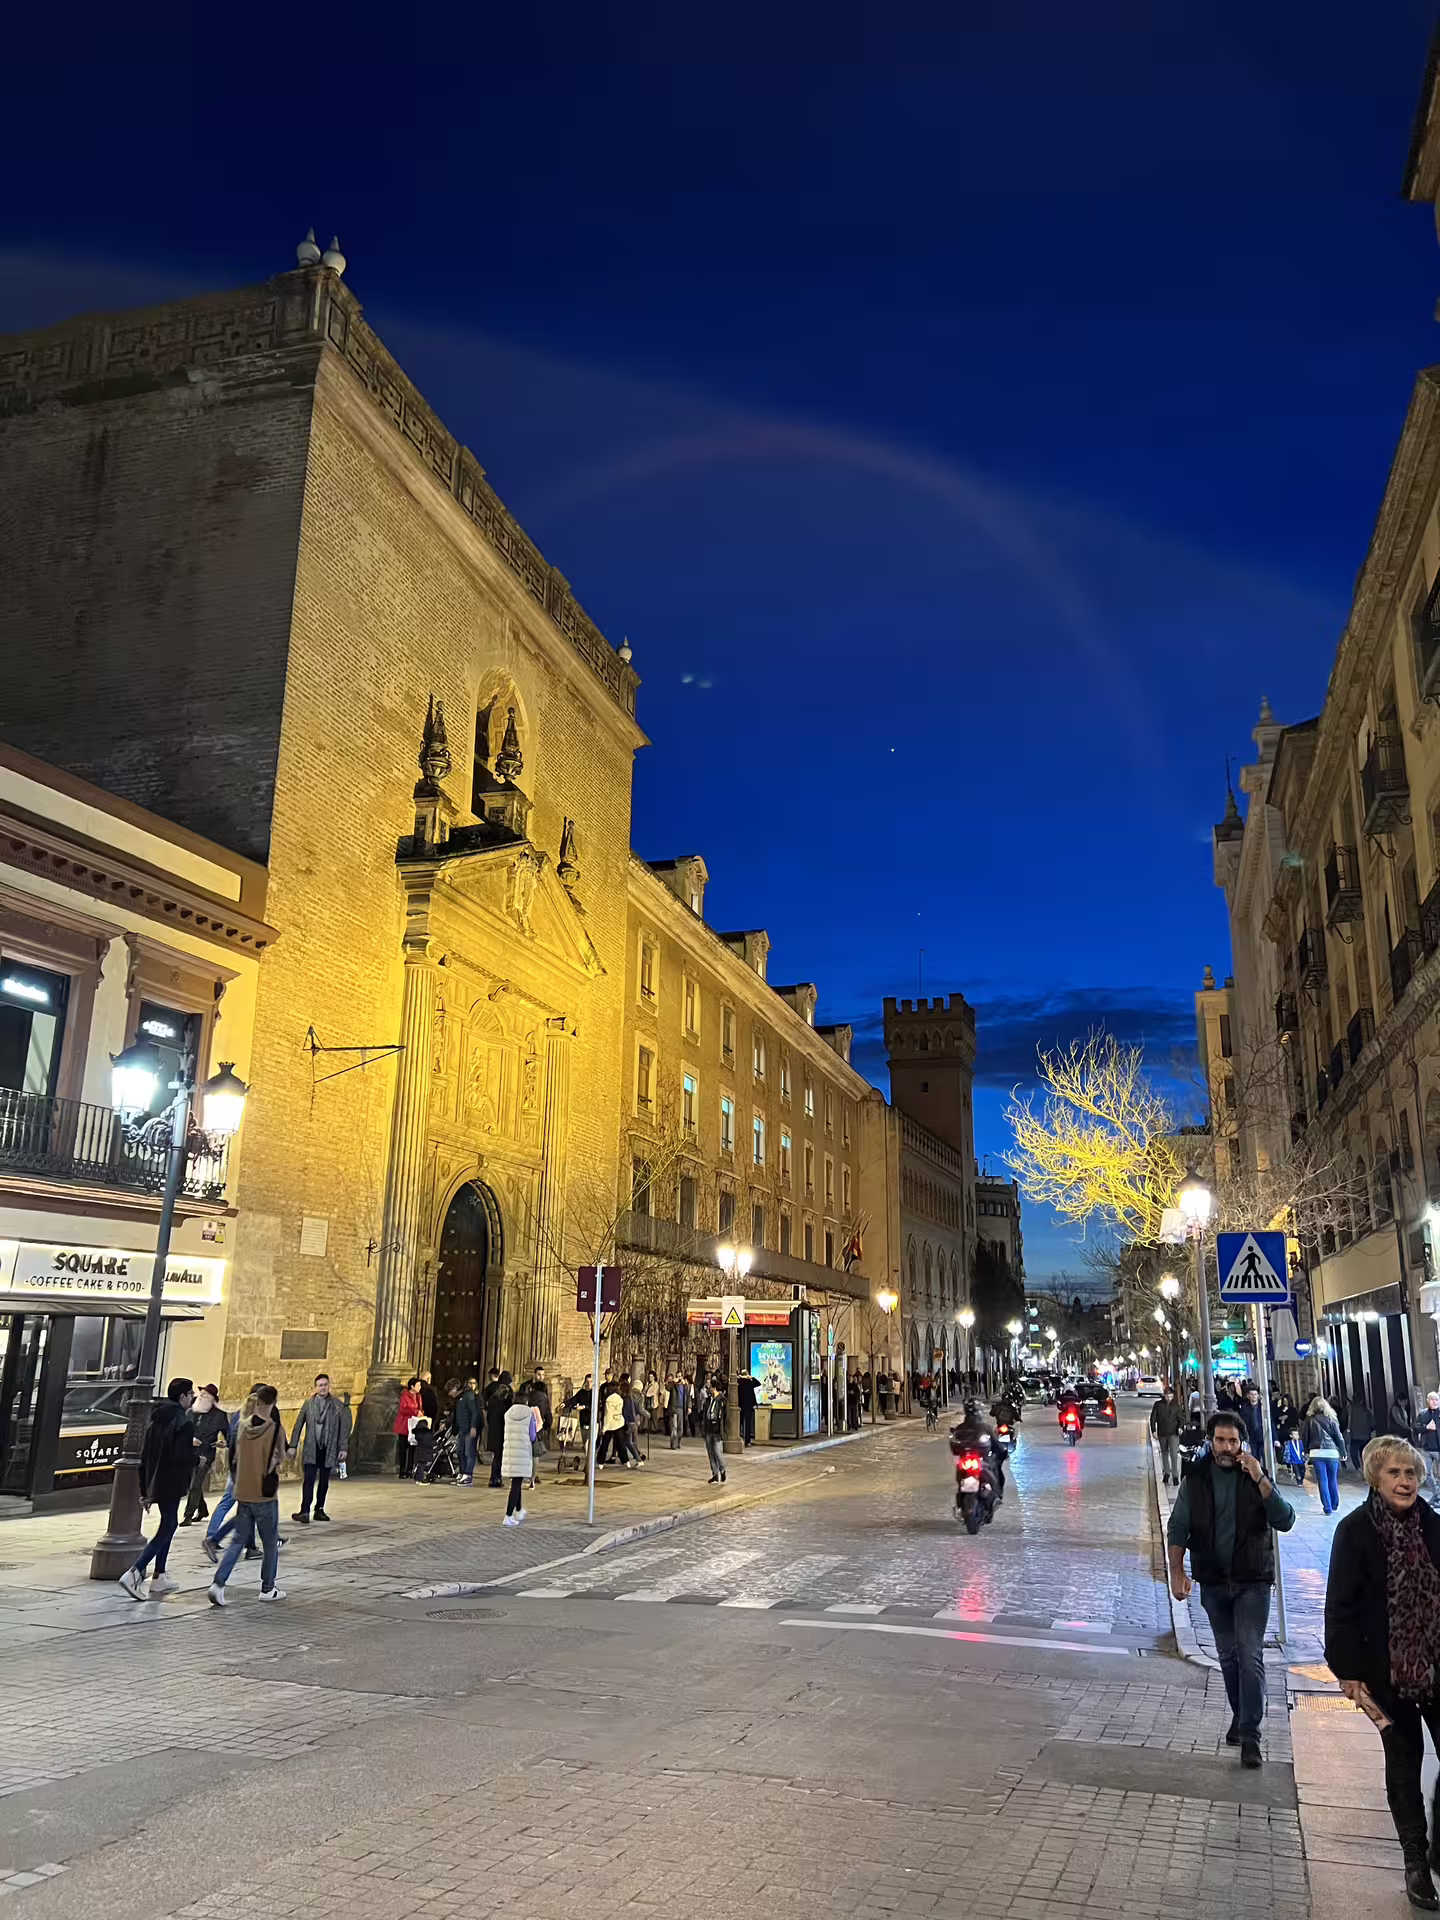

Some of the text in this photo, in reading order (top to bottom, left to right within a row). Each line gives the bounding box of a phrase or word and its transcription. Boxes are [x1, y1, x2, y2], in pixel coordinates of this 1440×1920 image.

[52, 1252, 131, 1276] SQUARE
[77, 1279, 104, 1290] CAKE
[107, 1280, 113, 1291] &
[758, 1352, 785, 1360] SEVILLA
